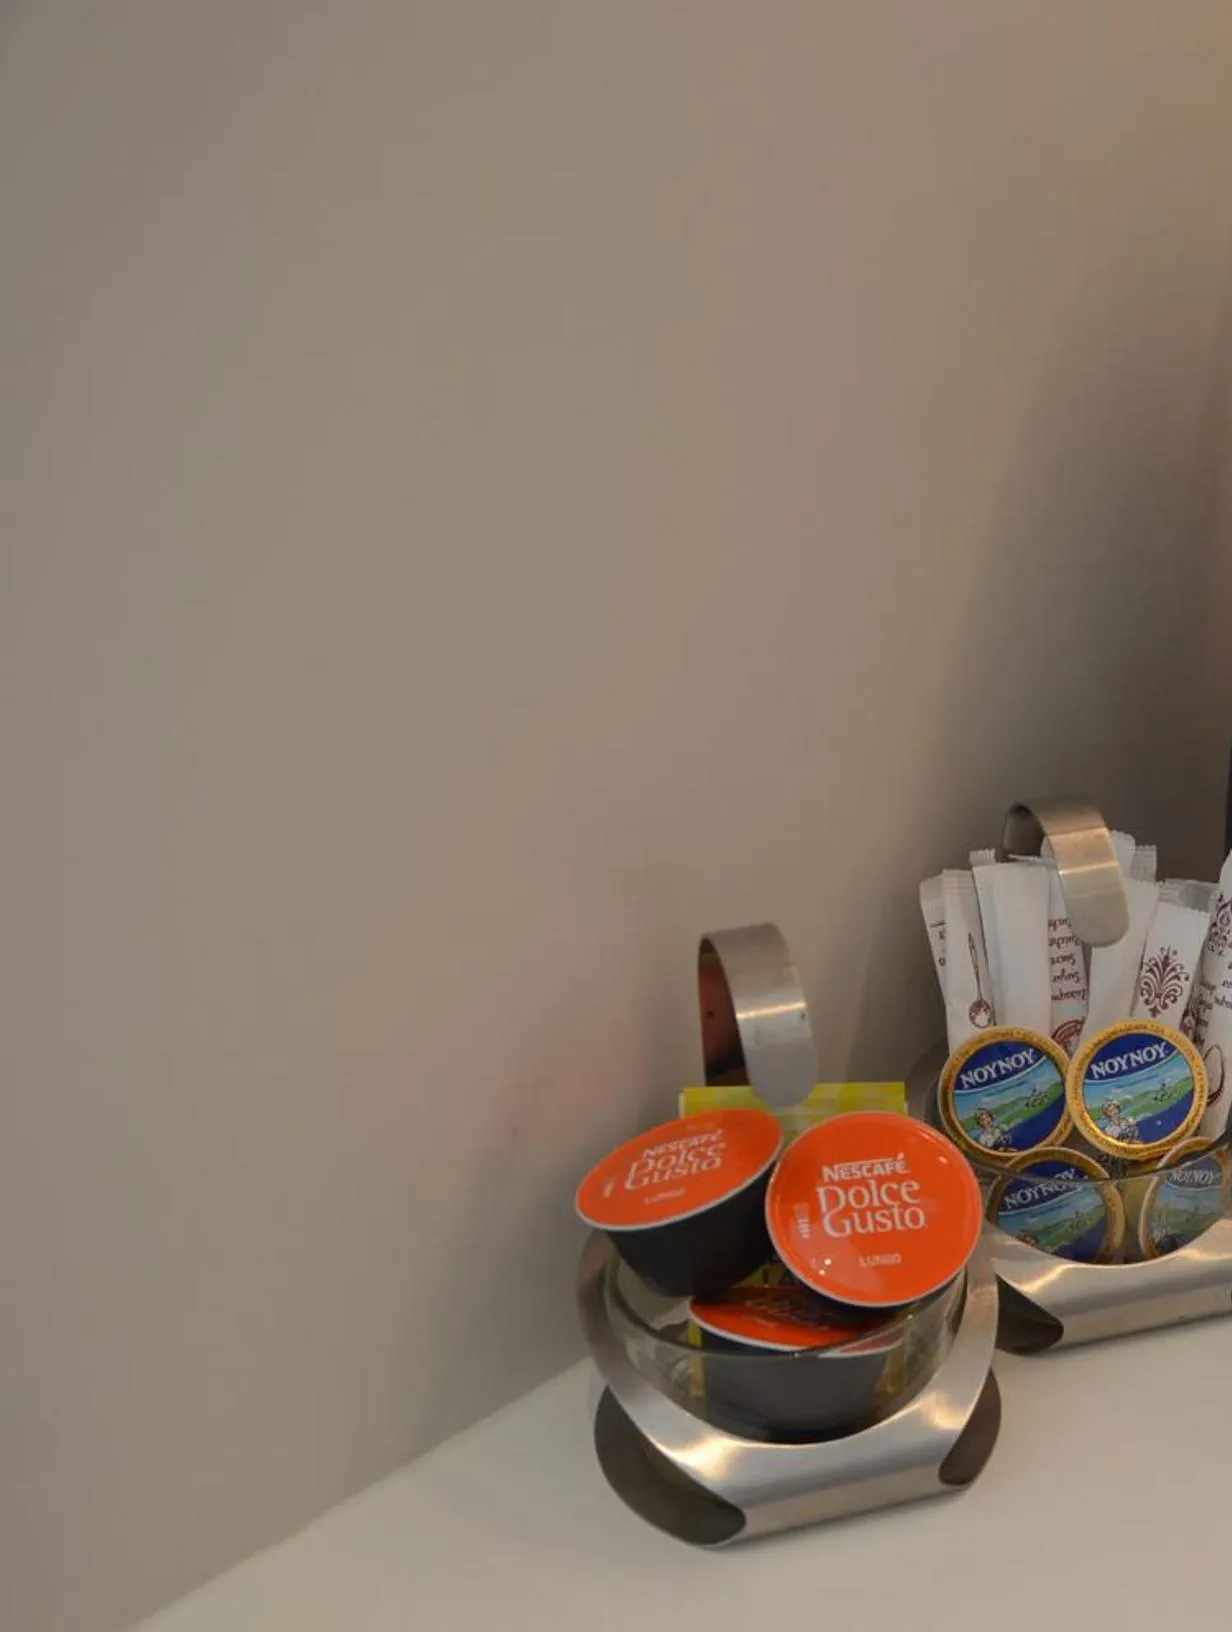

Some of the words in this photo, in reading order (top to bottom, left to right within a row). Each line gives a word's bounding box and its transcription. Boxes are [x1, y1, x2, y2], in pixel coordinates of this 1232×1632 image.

[624, 1155, 722, 1191] Gusto
[628, 1141, 726, 1182] Dolce
[822, 1151, 911, 1182] NESCAFÉ
[816, 1179, 921, 1214] Dolce
[822, 1203, 927, 1238] Gusto
